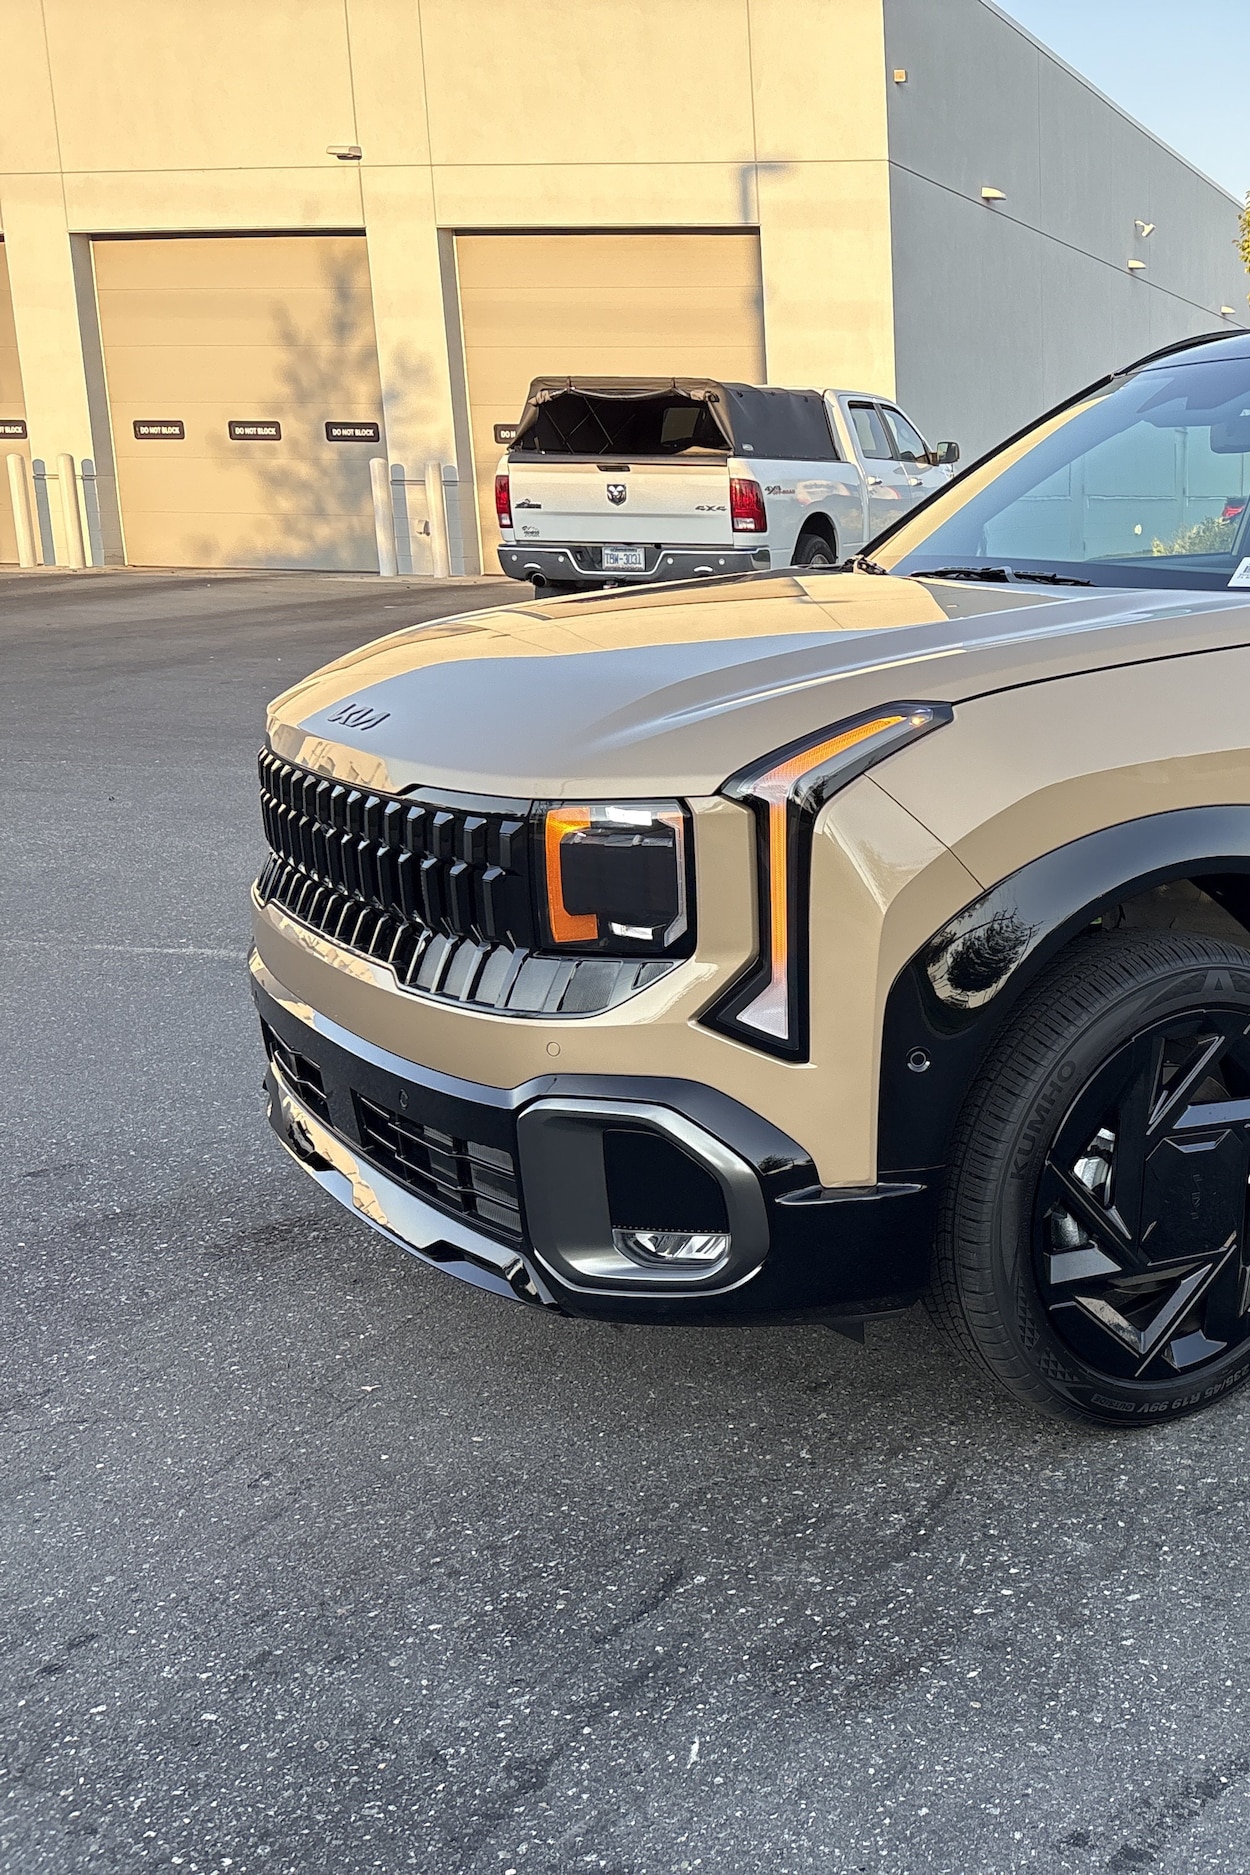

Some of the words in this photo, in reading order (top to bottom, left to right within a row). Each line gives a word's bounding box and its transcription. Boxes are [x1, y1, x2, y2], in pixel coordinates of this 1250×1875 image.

[5, 426, 23, 434] BLOCK
[235, 427, 244, 435] DO
[245, 427, 257, 435] NOT
[332, 428, 341, 436] DO
[342, 428, 354, 436] NOT
[355, 429, 374, 437] BLOCK
[501, 430, 510, 438] DO
[1010, 1060, 1077, 1181] KUMHO
[1204, 1363, 1250, 1398] 235/45
[1137, 1400, 1169, 1413] 99V
[1171, 1392, 1202, 1410] R19
